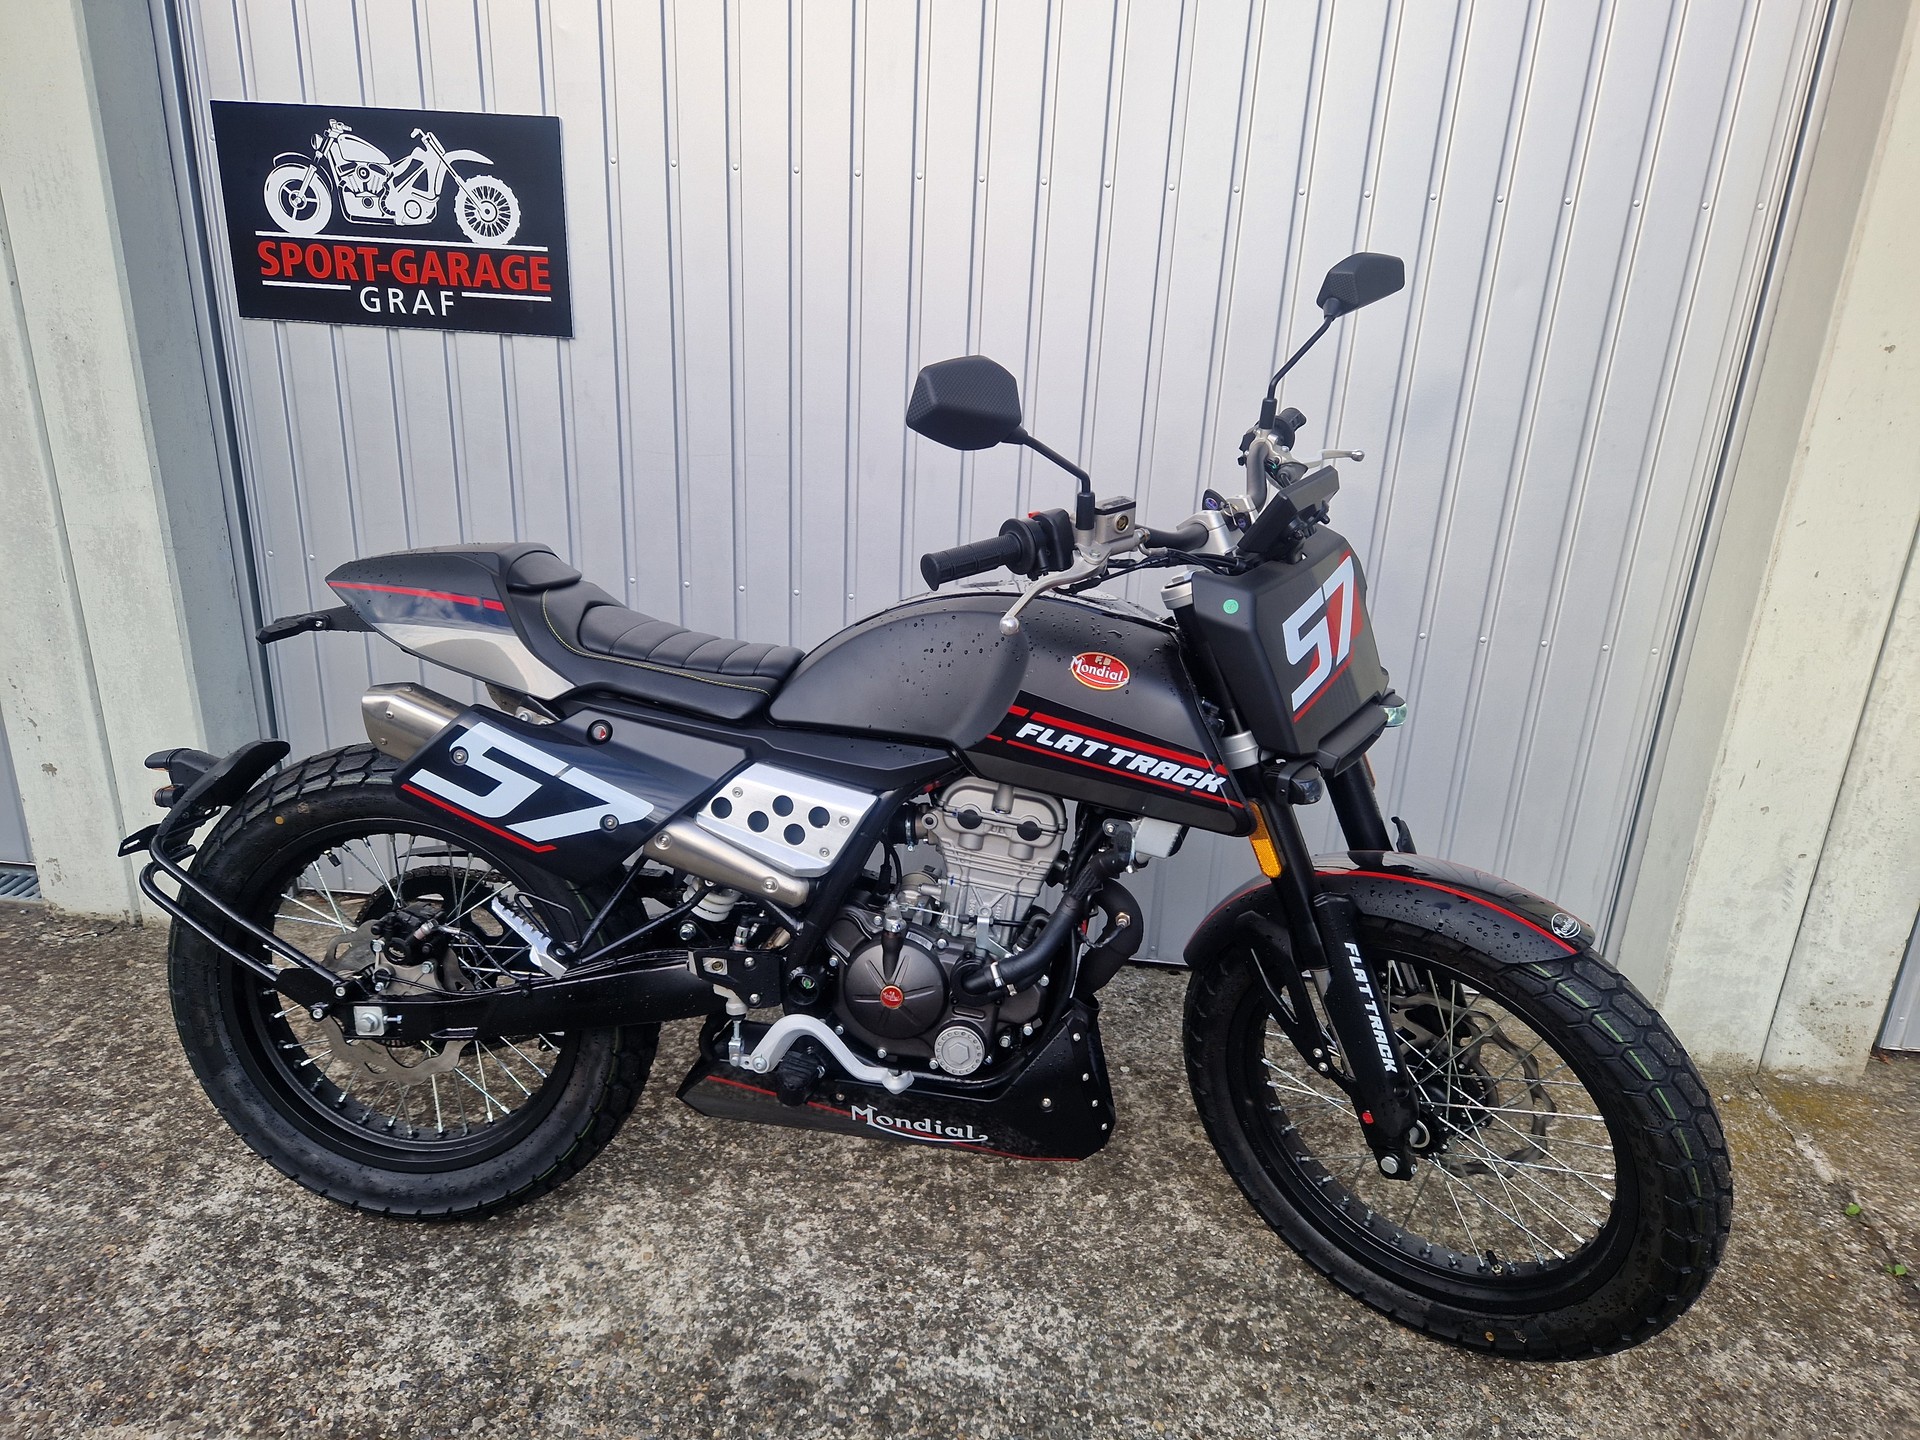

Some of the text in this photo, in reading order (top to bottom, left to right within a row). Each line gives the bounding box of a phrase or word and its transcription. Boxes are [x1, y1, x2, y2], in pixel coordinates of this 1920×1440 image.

[257, 240, 552, 292] SPORT-GARAGE
[359, 287, 455, 316] GRAF
[1282, 555, 1355, 712] 57
[1069, 656, 1128, 684] Mondial
[409, 721, 654, 842] 57
[1015, 722, 1227, 793] FLAT TRACK
[1344, 942, 1398, 1073] FLAT TRACK
[851, 1104, 987, 1142] Mondial
